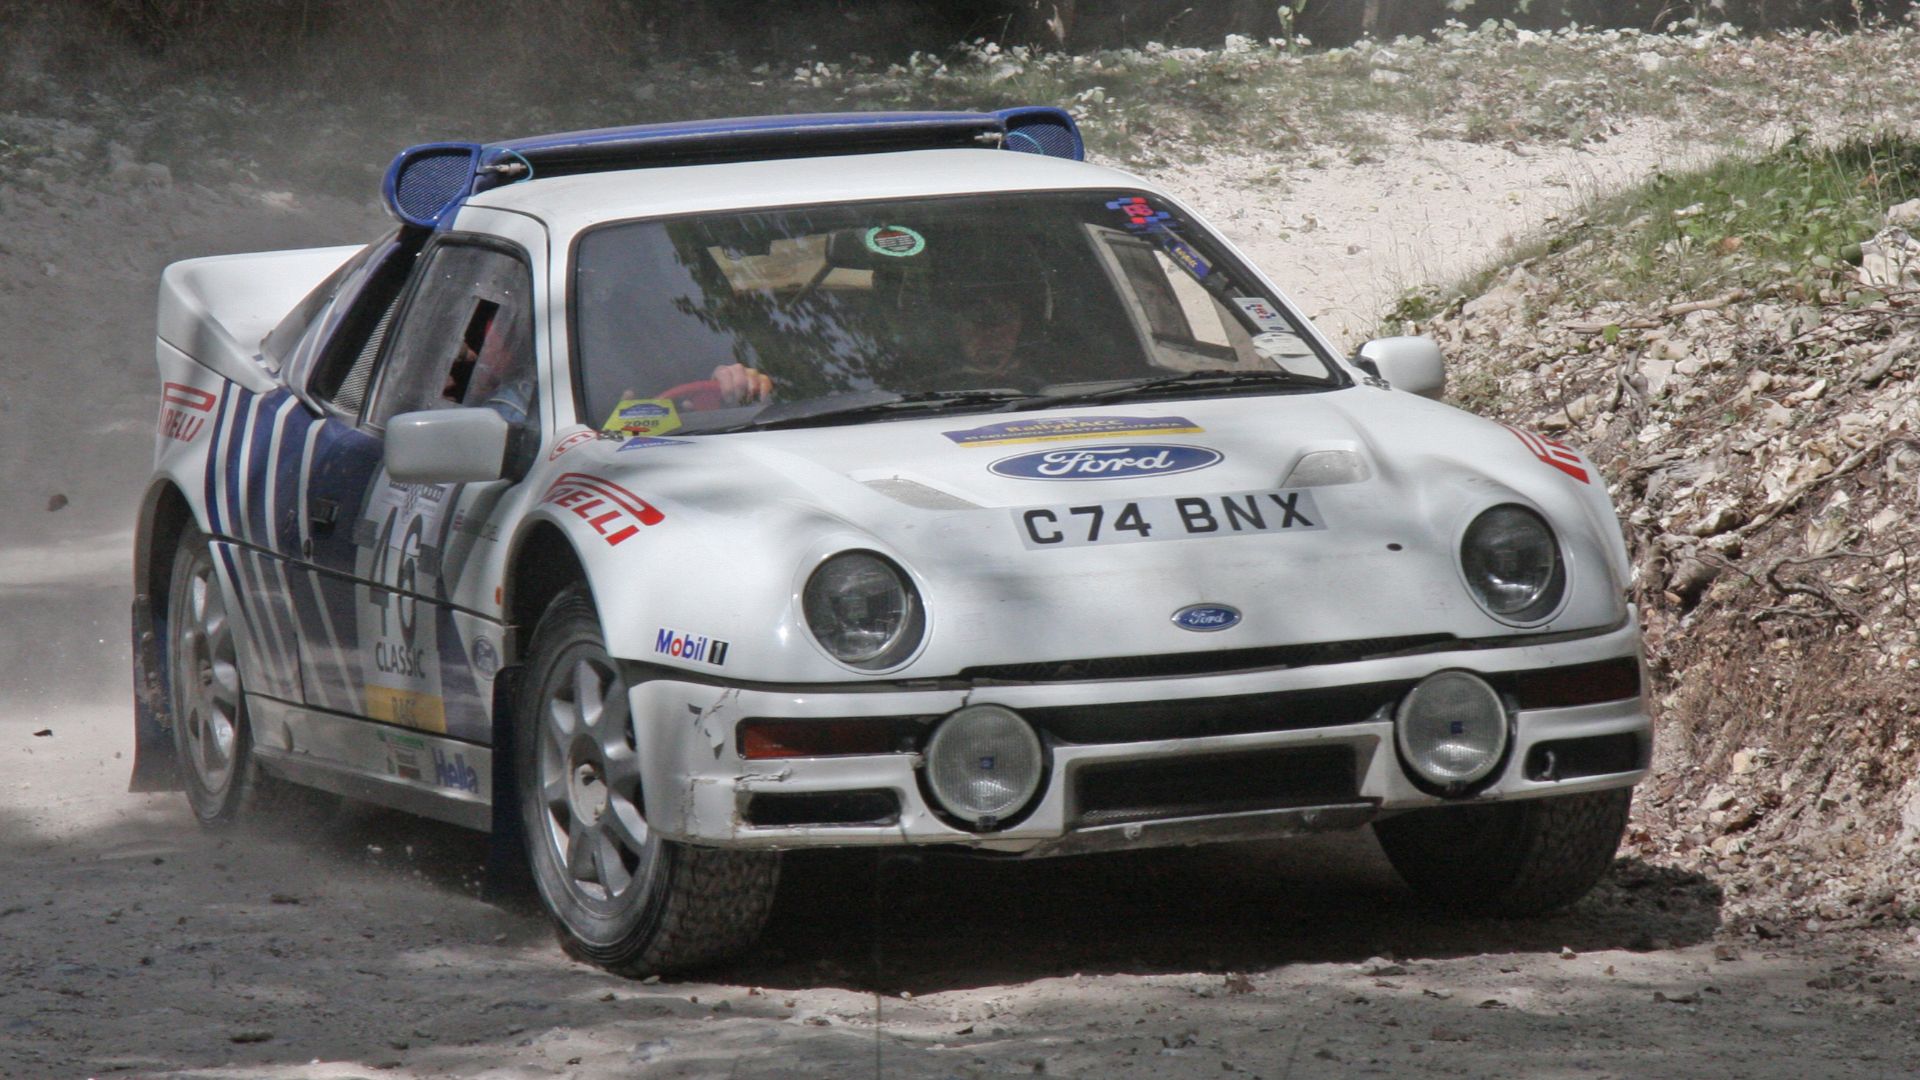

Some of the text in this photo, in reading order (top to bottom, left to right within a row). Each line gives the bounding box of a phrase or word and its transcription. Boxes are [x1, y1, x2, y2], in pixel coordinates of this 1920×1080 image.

[1037, 448, 1175, 476] Ford
[542, 472, 666, 547] PRELLI
[1023, 492, 1315, 544] C74 BNX
[1188, 609, 1227, 625] Ford
[375, 641, 426, 679] CLASSIC
[655, 628, 727, 665] Mobil 1
